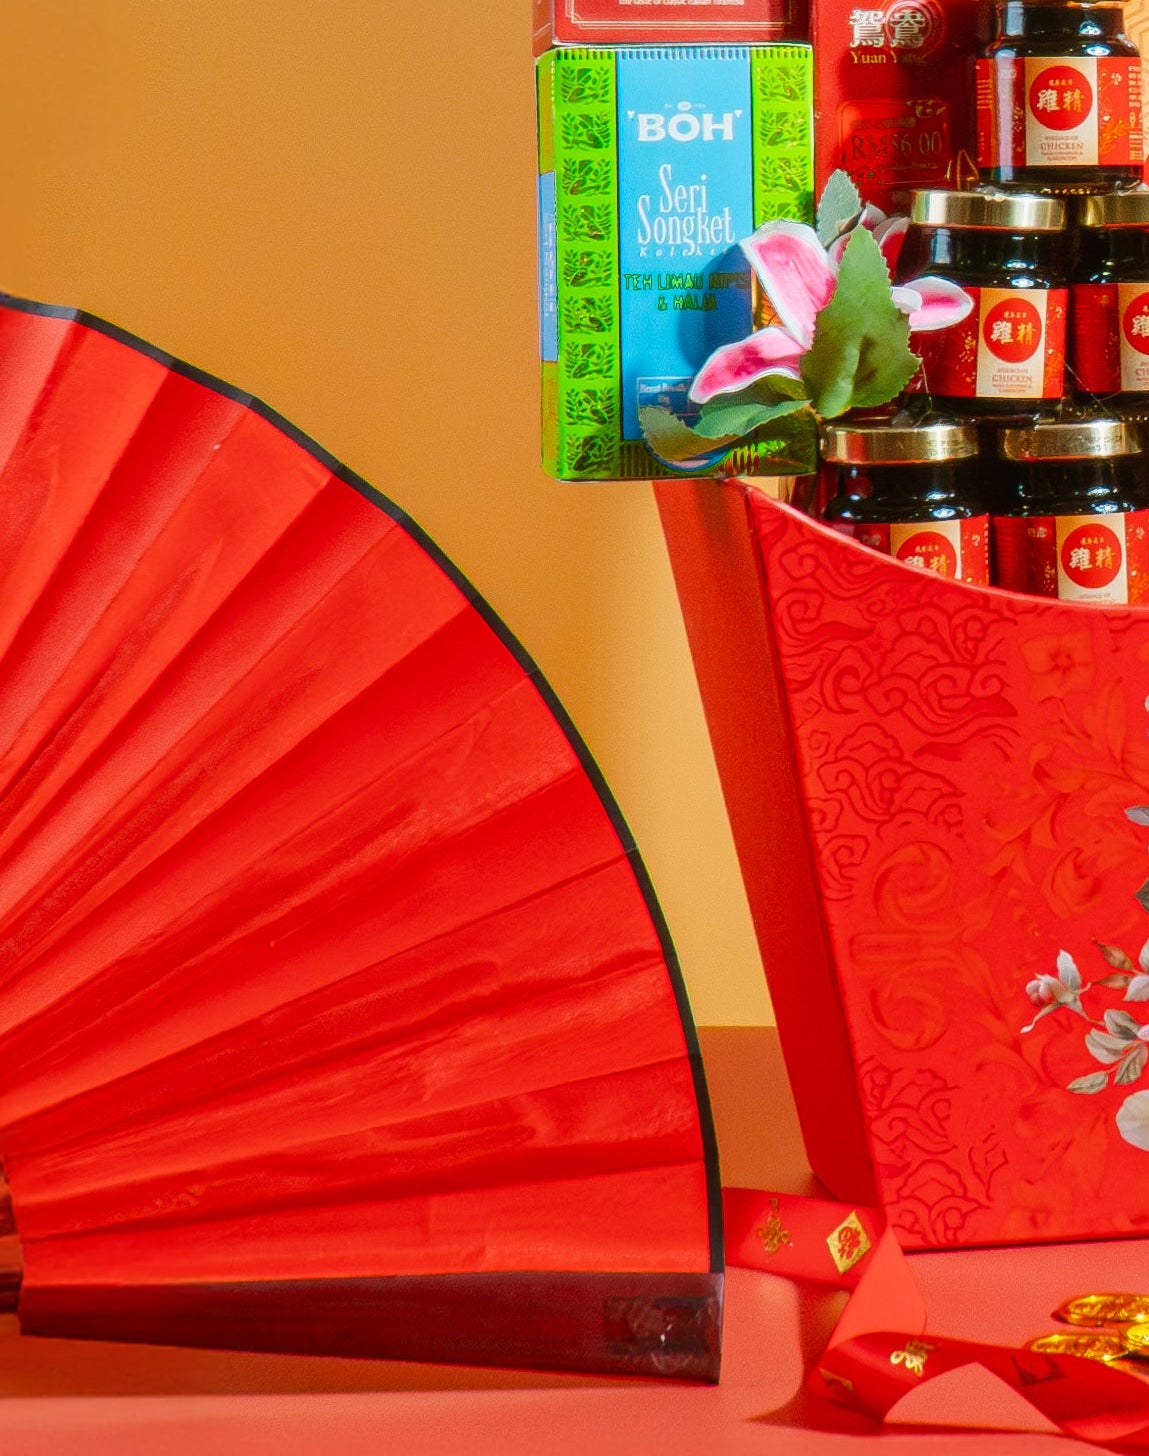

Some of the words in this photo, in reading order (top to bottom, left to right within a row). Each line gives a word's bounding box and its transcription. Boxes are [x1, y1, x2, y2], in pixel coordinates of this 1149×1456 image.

[850, 50, 887, 65] Yuan
[659, 163, 707, 213] Seri
[637, 194, 736, 255] Songket
[623, 273, 653, 291] TEH
[657, 273, 704, 291] LIMAU
